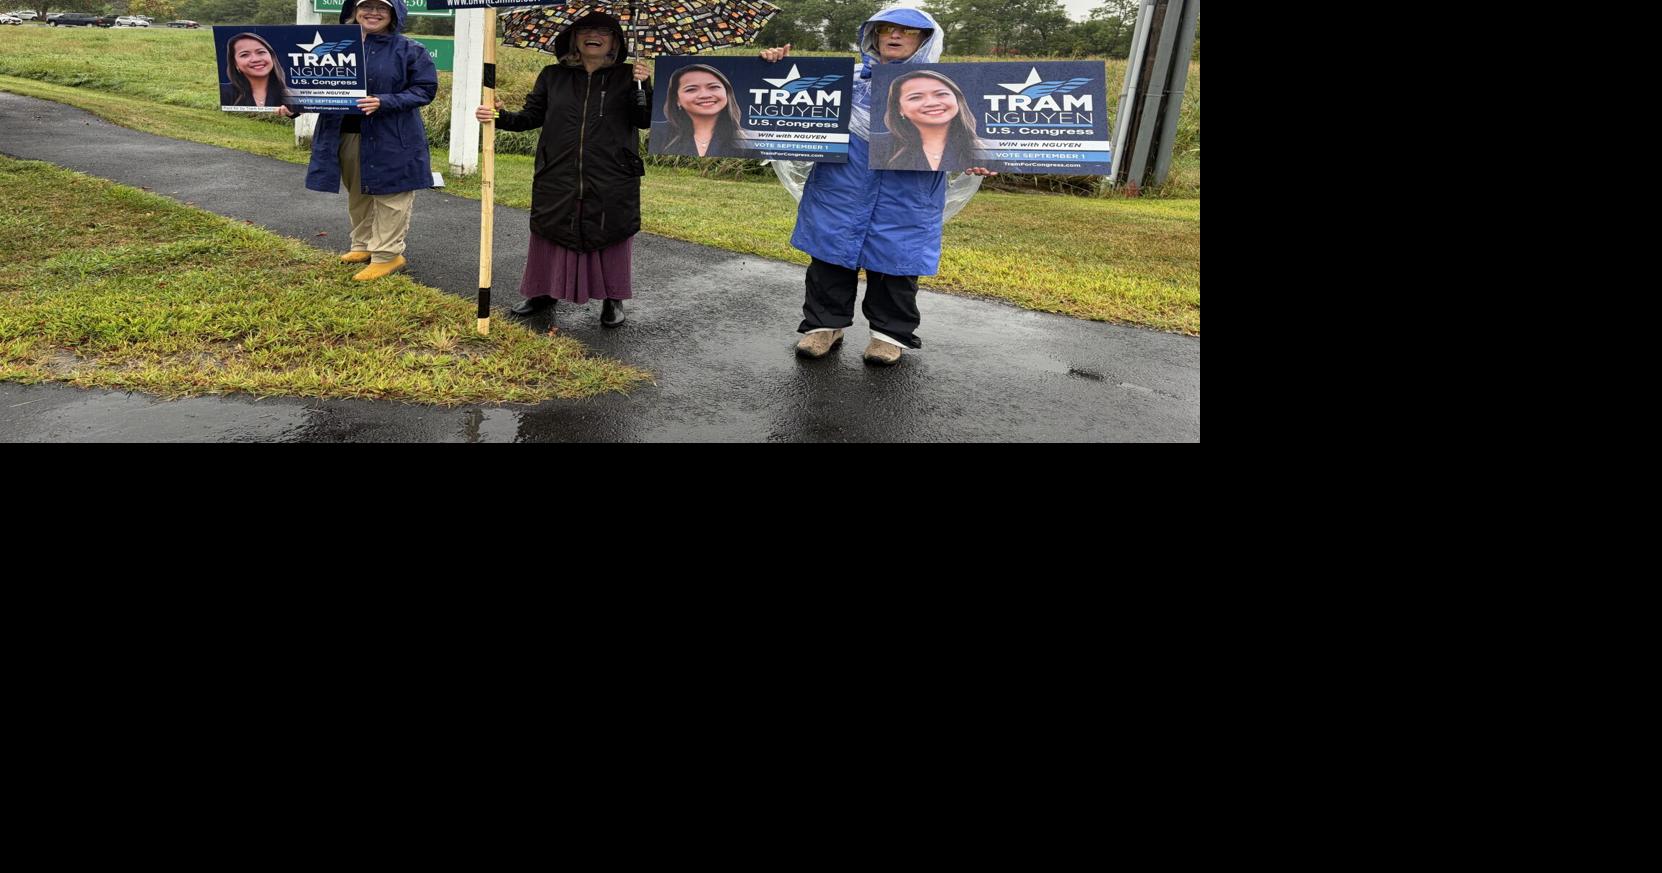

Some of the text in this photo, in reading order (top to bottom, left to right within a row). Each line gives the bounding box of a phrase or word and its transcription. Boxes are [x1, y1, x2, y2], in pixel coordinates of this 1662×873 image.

[288, 53, 357, 67] TRAM
[290, 67, 357, 77] NGUYEN
[749, 89, 842, 106] TRAM
[983, 94, 1093, 112] TRAM
[748, 105, 840, 118] NGUYEN
[776, 120, 839, 129] Congress
[984, 112, 1093, 125] NGUYEN
[1018, 127, 1095, 137] Congress
